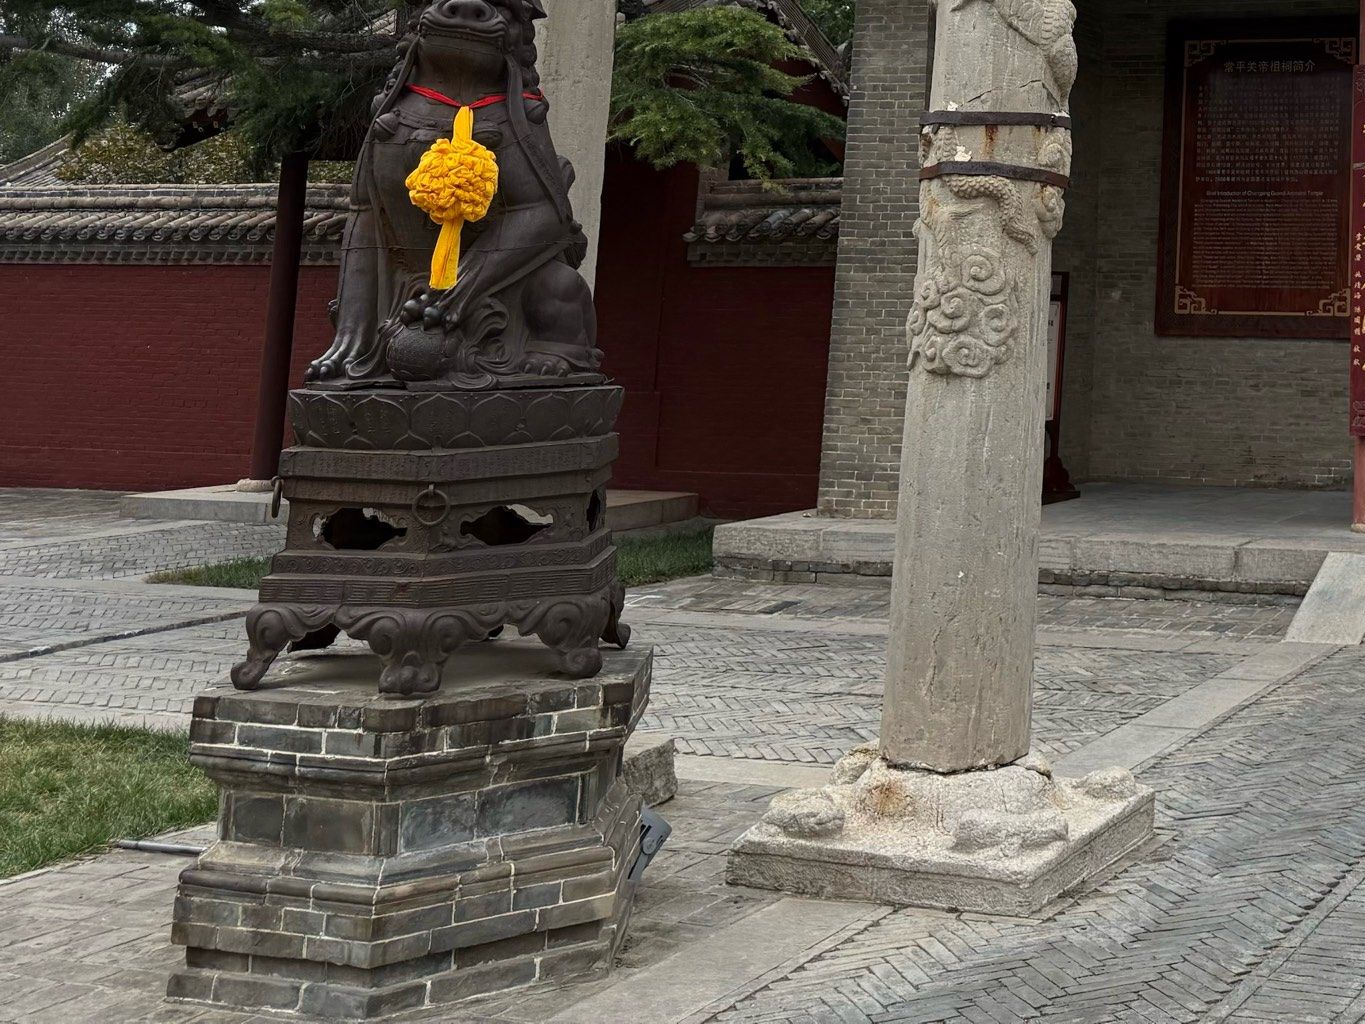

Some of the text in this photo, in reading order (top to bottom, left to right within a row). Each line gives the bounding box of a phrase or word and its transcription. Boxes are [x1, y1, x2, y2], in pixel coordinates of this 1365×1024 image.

[1223, 59, 1316, 73] 常平关帝祖祠简介
